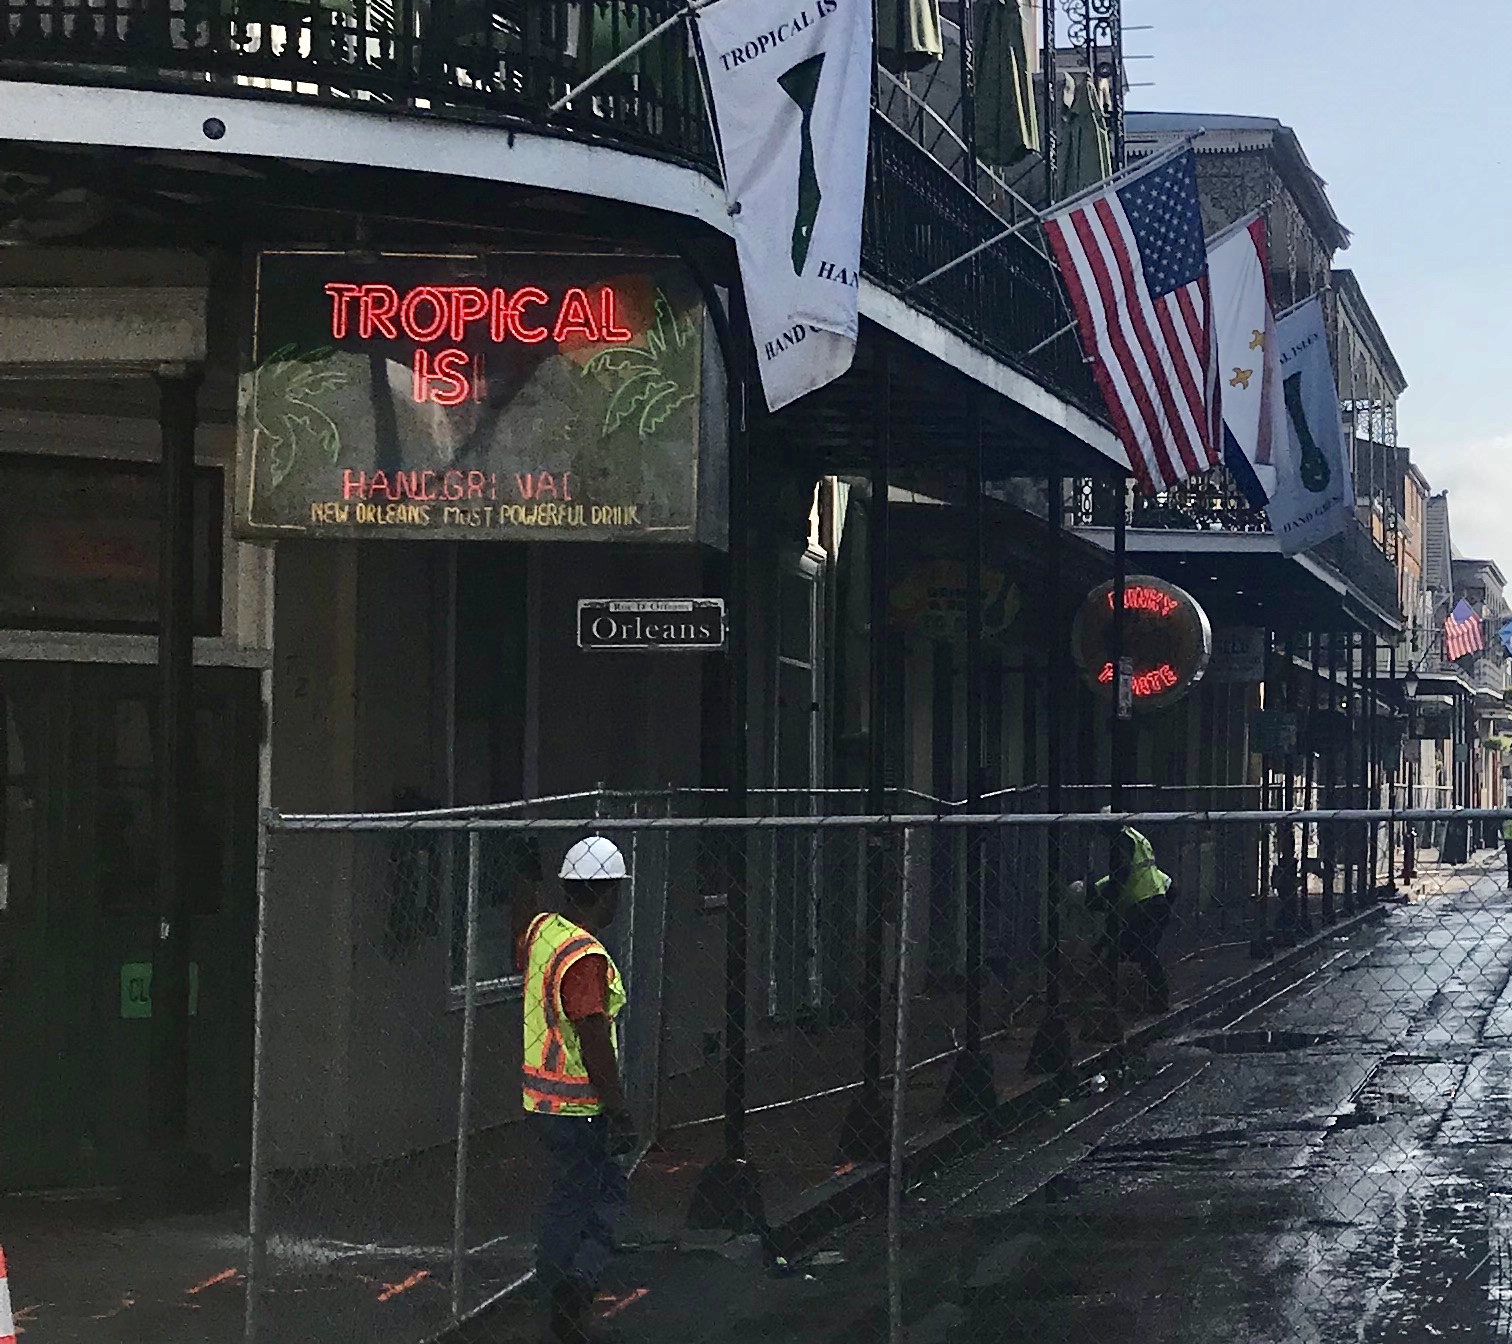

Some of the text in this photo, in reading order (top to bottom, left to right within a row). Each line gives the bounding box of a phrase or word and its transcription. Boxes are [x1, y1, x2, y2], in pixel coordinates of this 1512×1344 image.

[719, 11, 814, 71] TROPICAL
[818, 261, 858, 289] HAN
[325, 283, 631, 343] TROPICAL
[765, 324, 806, 361] HAND
[311, 503, 641, 528] NEW ORLEANS MOST POWERFUL DRINK
[1283, 512, 1313, 533] HAND
[592, 617, 710, 640] Orleans
